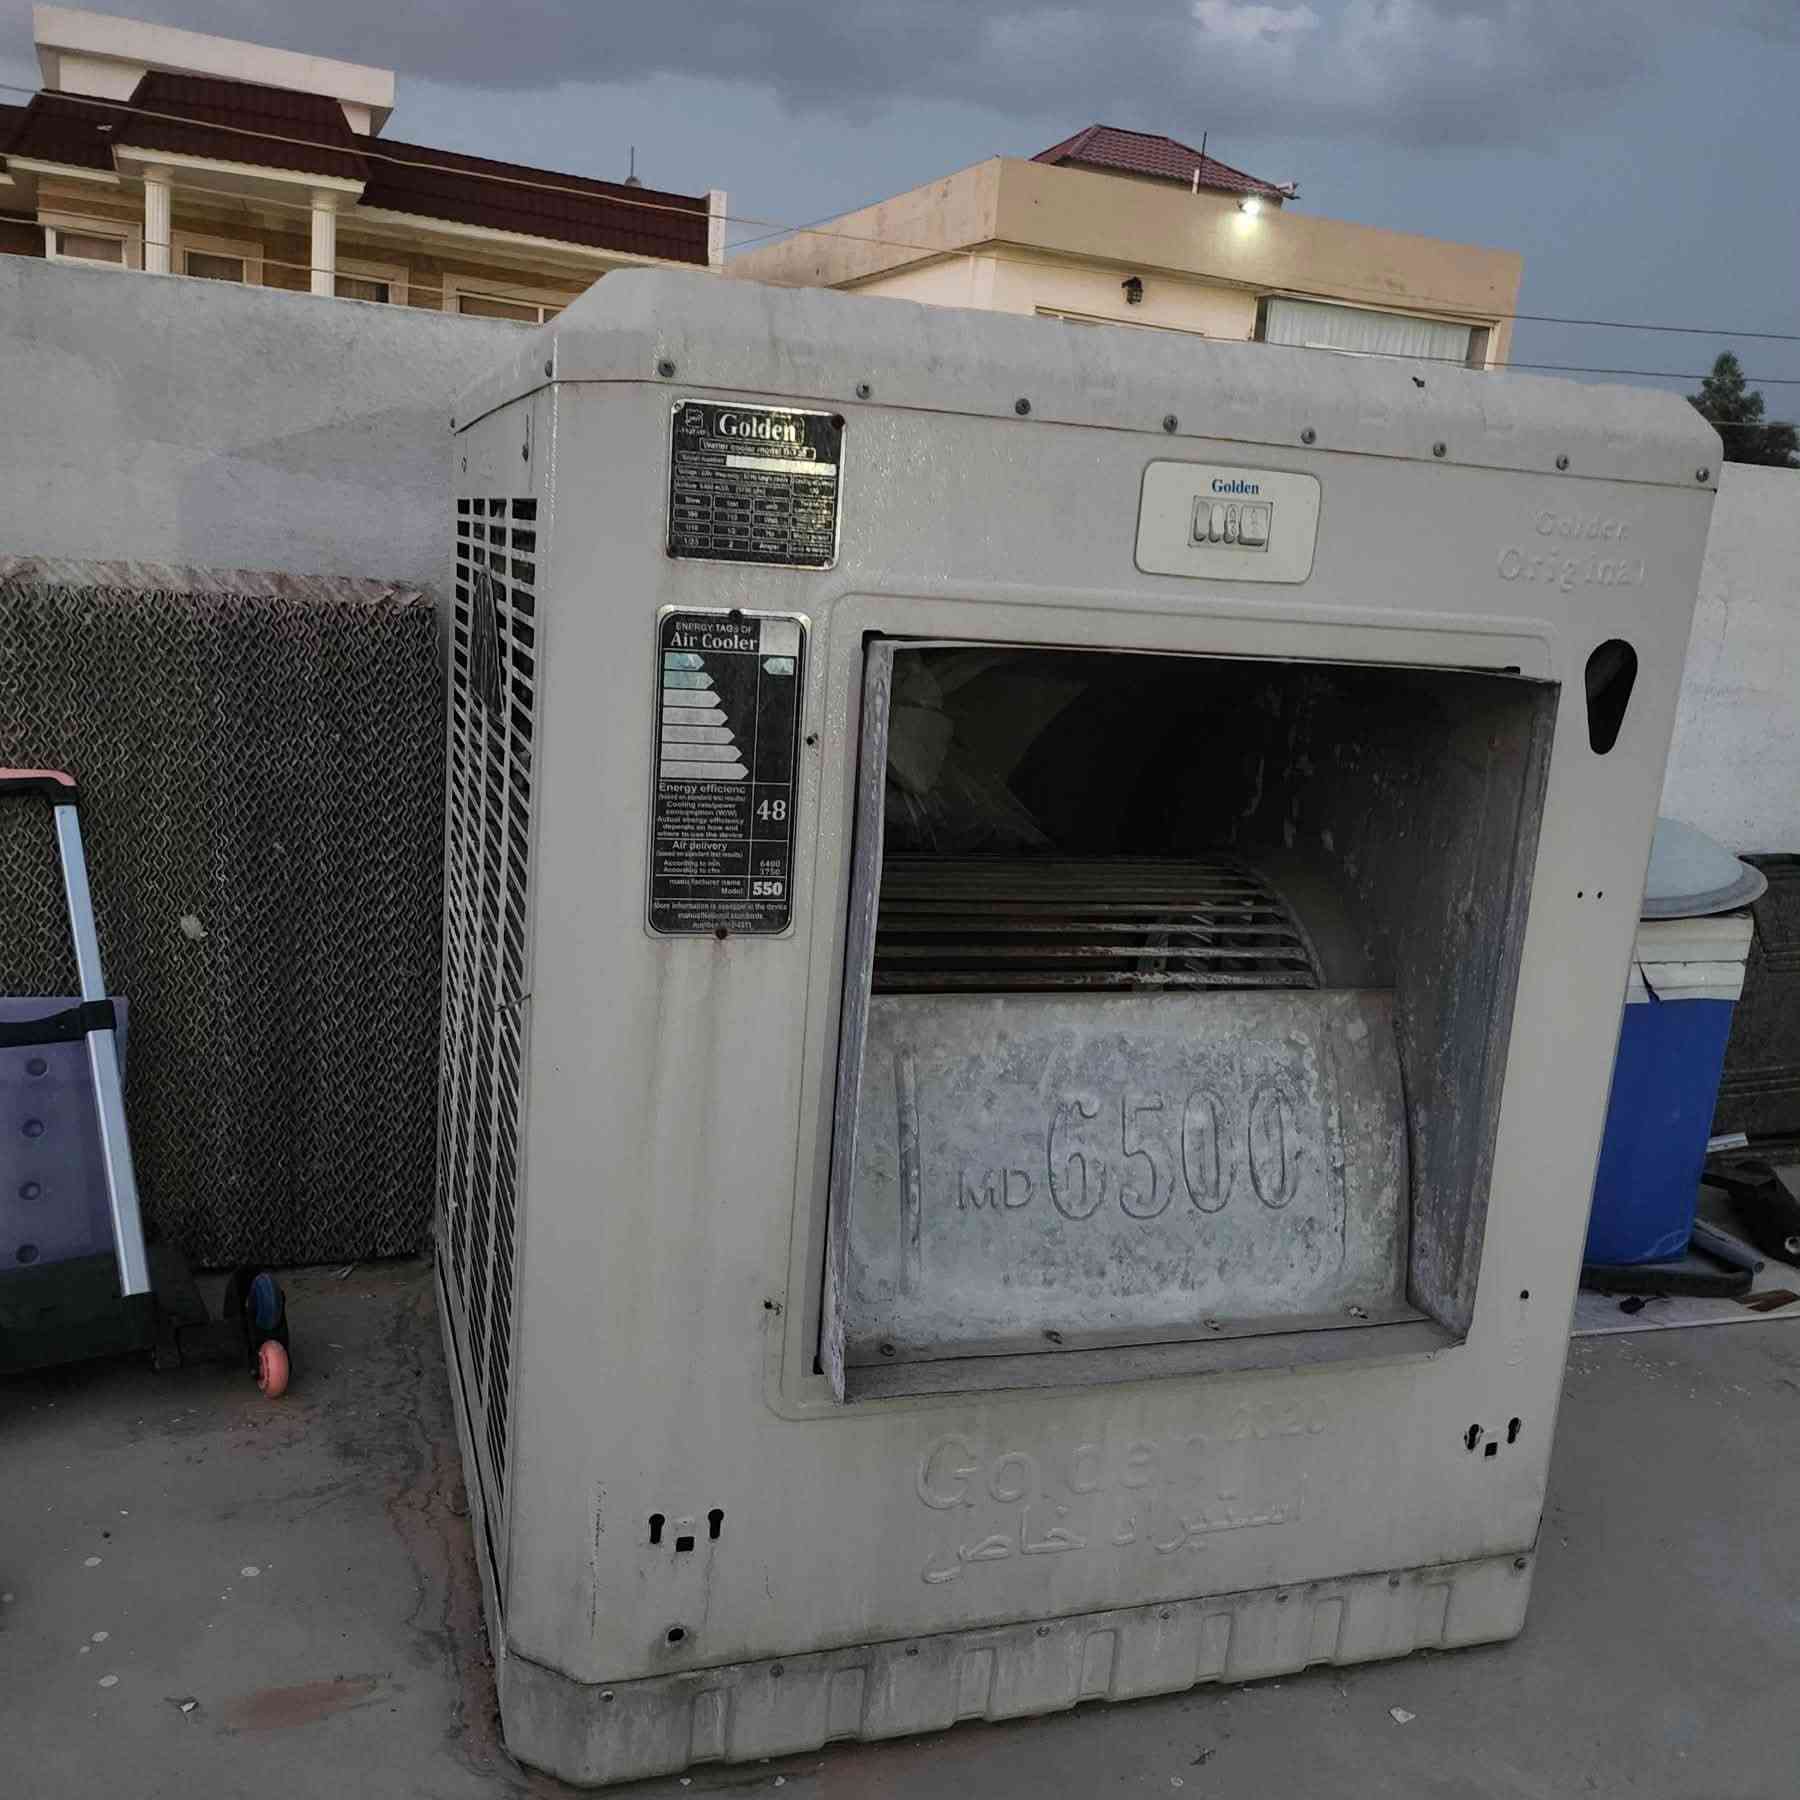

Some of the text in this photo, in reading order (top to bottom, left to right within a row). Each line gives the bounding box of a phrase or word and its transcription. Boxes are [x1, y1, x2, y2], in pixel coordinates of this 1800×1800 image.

[719, 413, 796, 442] Golden
[1211, 478, 1260, 495] Golden
[1496, 547, 1648, 593] Original
[675, 621, 713, 632] ENERGY
[671, 632, 758, 650] Air Cooler
[658, 783, 698, 794] Energy
[666, 800, 696, 809] Cooling
[756, 799, 786, 821] 48
[672, 840, 728, 851] Air delivery
[752, 881, 783, 896] 550
[956, 1086, 1303, 1222] MD 6500
